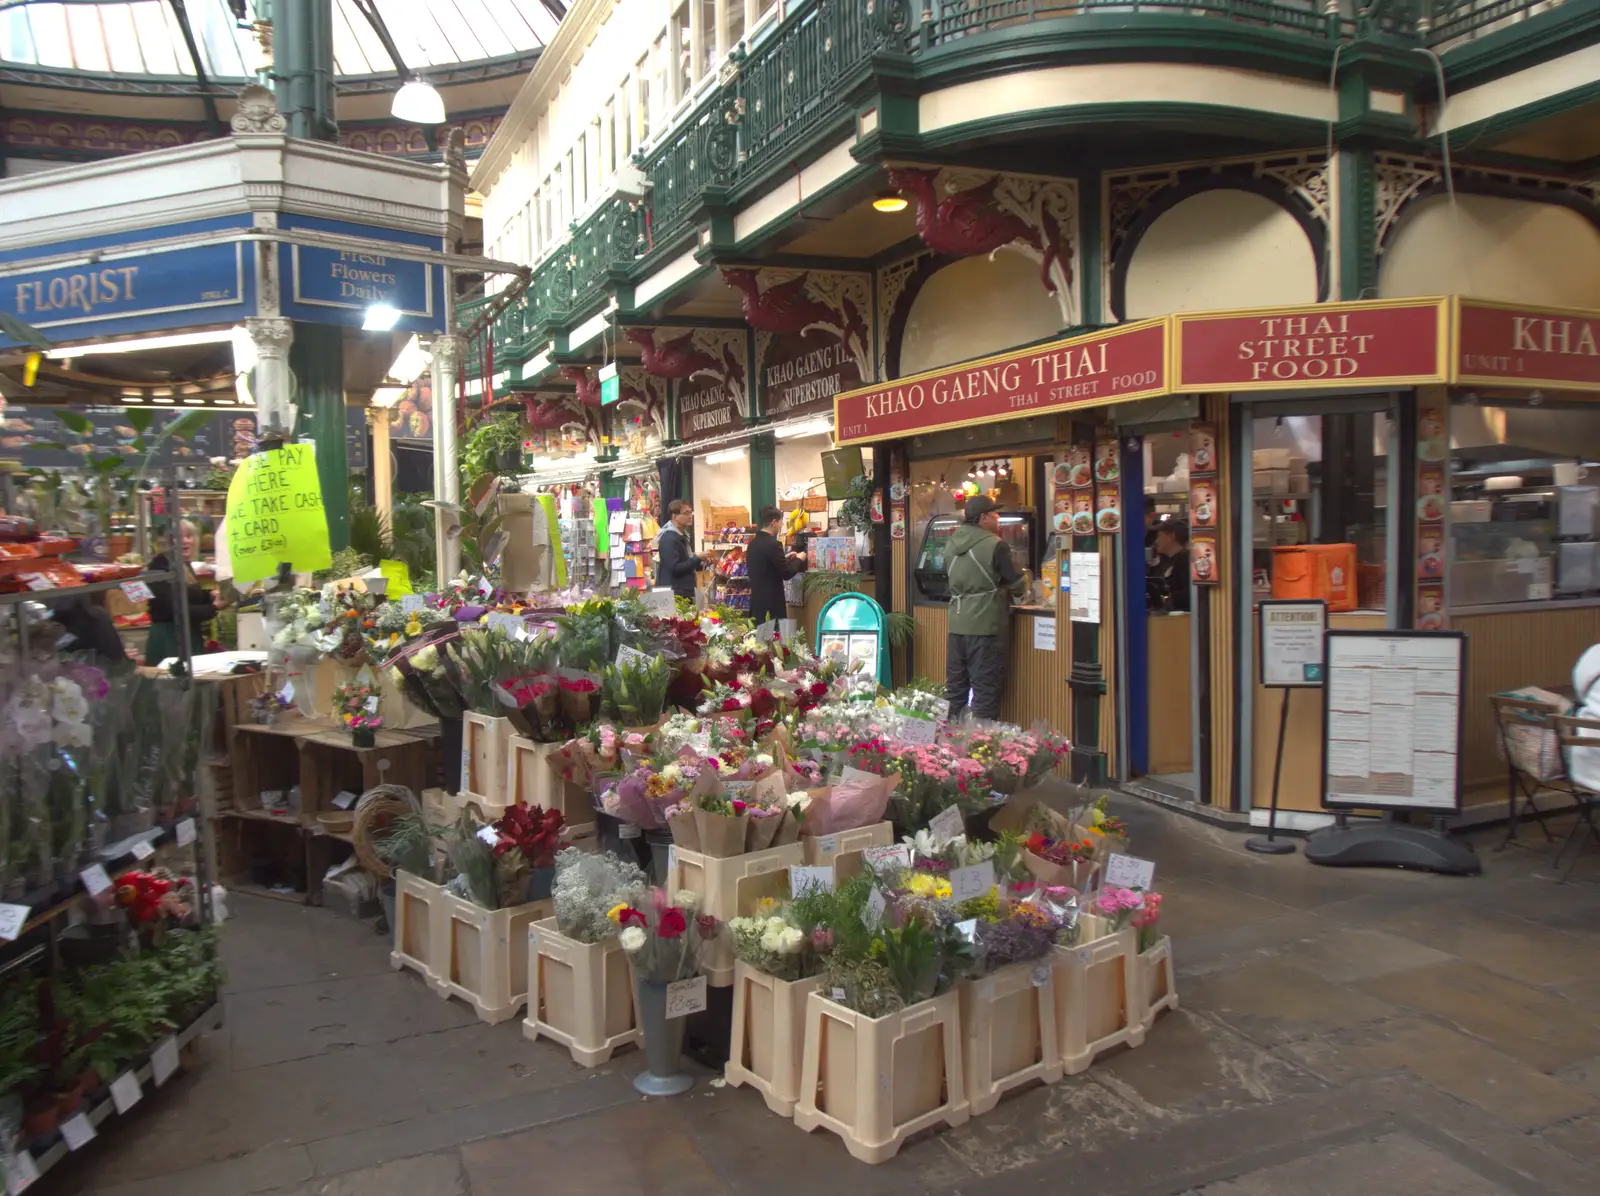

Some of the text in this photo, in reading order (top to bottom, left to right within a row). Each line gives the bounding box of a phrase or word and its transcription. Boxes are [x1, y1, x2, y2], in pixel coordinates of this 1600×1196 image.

[331, 262, 396, 285] Flowers
[16, 265, 139, 314] FLORIST
[340, 281, 387, 301] Daily
[1259, 314, 1350, 337] THAI
[1238, 334, 1375, 360] STREET
[766, 361, 795, 387] KHAO
[795, 346, 833, 377] GAENG
[1251, 356, 1360, 380] FOOD
[1464, 354, 1510, 371] UNIT
[784, 372, 842, 408] SUPERSTORE
[865, 342, 1109, 419] KHAO GAENG THAI
[1008, 369, 1158, 408] THAI STREET FOOD
[680, 384, 726, 413] KHAO GAENG
[692, 405, 732, 432] SUPERSTORE
[842, 425, 863, 437] UNIT
[278, 447, 304, 466] PAY
[247, 470, 291, 495] HERE
[251, 495, 289, 514] TAKE
[294, 491, 324, 509] CASH
[244, 518, 280, 536] CARD
[959, 869, 983, 895] £3
